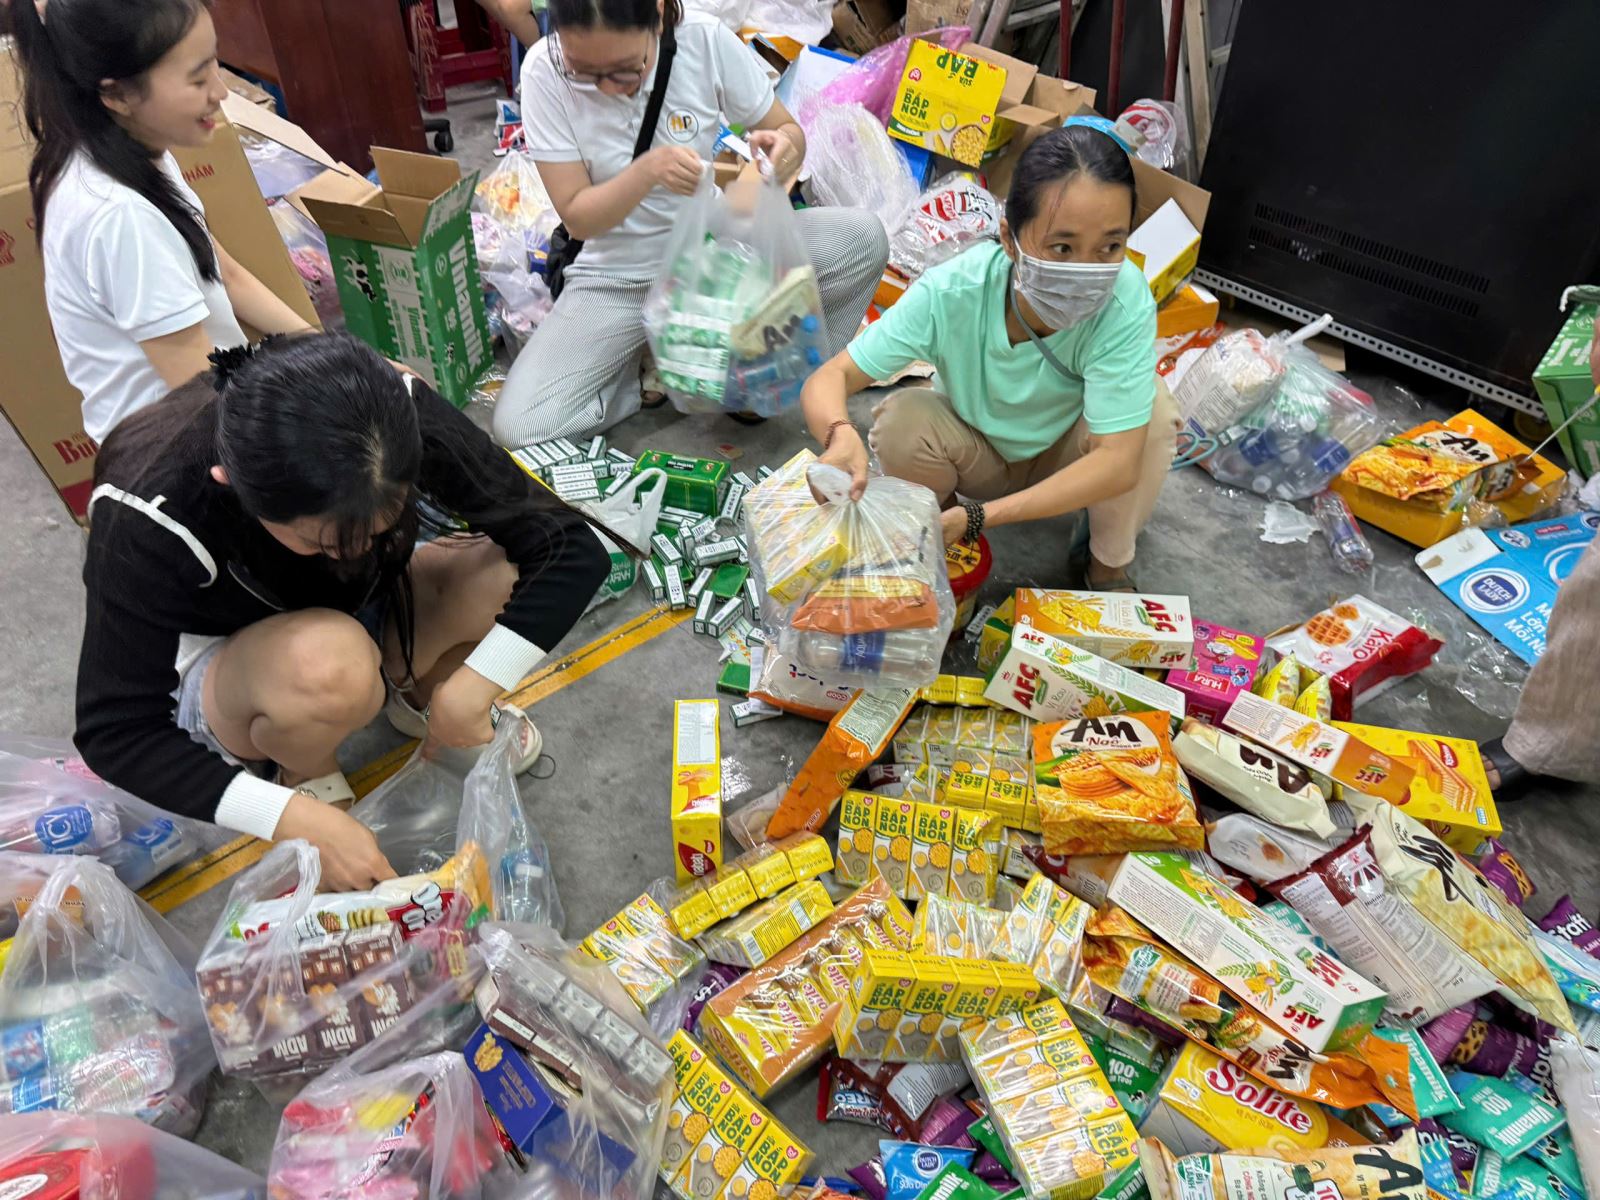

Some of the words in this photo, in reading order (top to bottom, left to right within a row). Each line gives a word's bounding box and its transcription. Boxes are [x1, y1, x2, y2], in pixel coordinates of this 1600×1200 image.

[901, 103, 928, 120] NON
[449, 234, 485, 375] Vinamilk
[1440, 432, 1491, 463] An
[1477, 585, 1503, 602] LADY
[1482, 577, 1514, 601] DUTCH
[1139, 597, 1179, 633] AFC
[1020, 632, 1045, 644] AFC
[1354, 628, 1394, 661] Karo
[1159, 652, 1186, 664] AFC
[1011, 662, 1042, 711] AFC
[1193, 673, 1223, 690] HURA
[1059, 717, 1143, 743] An
[1239, 744, 1312, 795] An
[1354, 769, 1388, 785] AFC
[843, 814, 870, 828] NON
[844, 802, 870, 817] BẮP
[879, 809, 908, 827] BẮP
[47, 813, 74, 844] ICY
[878, 820, 907, 836] NON
[917, 827, 947, 842] NON
[918, 815, 948, 832] BẮP
[828, 965, 852, 993] olite
[871, 996, 902, 1009] NON
[874, 987, 905, 1002] BẮP
[916, 991, 948, 1006] BẮP
[959, 993, 989, 1009] BẮP
[911, 1001, 944, 1013] NON
[953, 1003, 985, 1015] NON
[1282, 1004, 1325, 1029] AFC
[271, 1034, 308, 1056] ADM
[320, 1025, 358, 1049] ADM
[695, 1077, 722, 1105] BẮP
[1205, 1058, 1313, 1134] Solite
[688, 1089, 714, 1120] NON
[725, 1105, 753, 1137] BẮP
[1494, 1103, 1555, 1147] Vinamilk
[718, 1119, 745, 1151] NON
[752, 1151, 781, 1183] NON
[760, 1140, 788, 1170] BẮP
[1351, 1145, 1425, 1195] A
